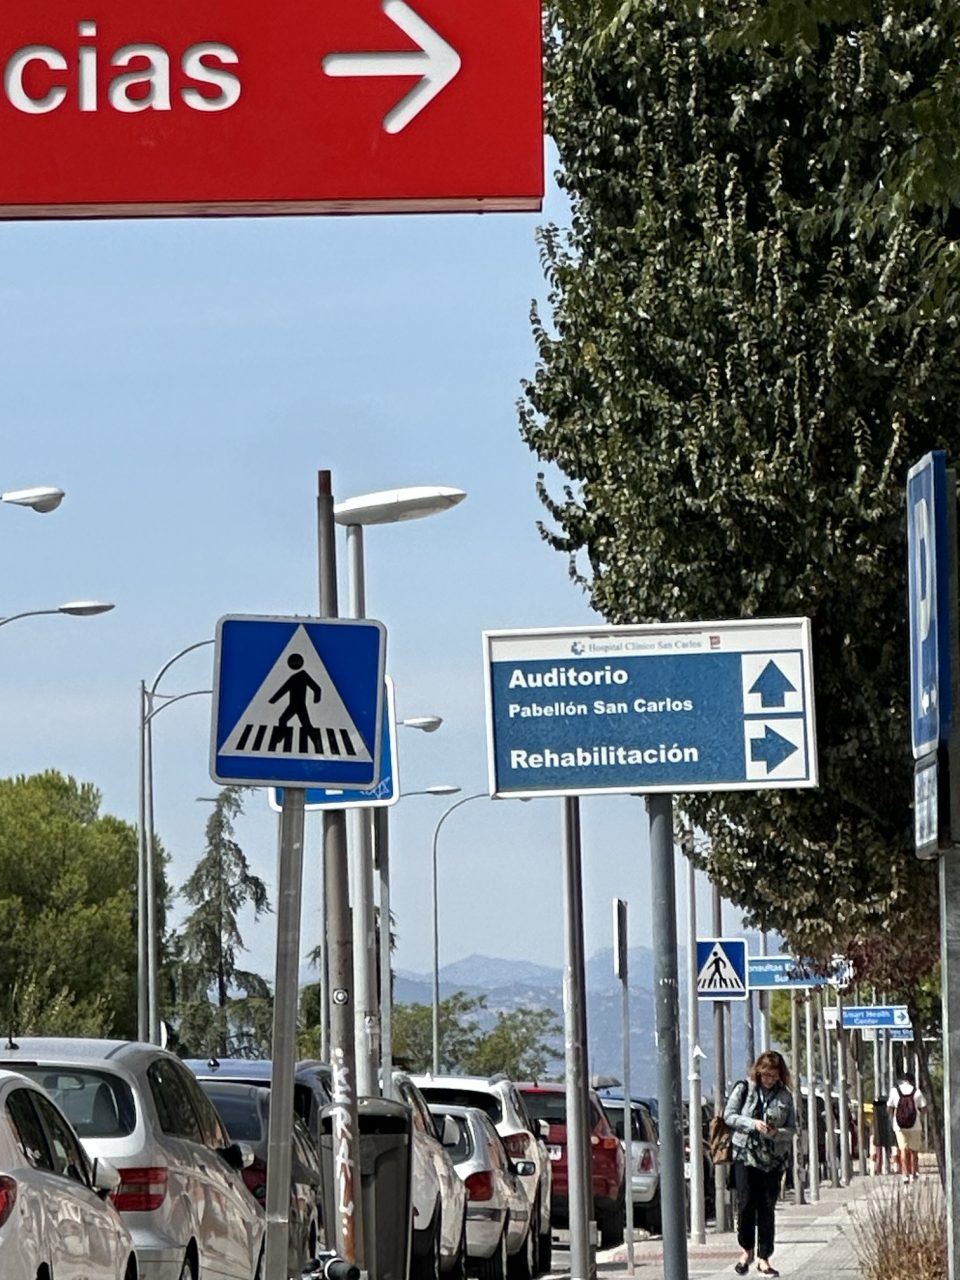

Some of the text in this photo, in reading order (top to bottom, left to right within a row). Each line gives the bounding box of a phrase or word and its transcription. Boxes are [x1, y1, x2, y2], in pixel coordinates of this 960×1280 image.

[657, 640, 673, 649] San
[674, 639, 702, 649] Carlos
[508, 665, 628, 689] Auditorio
[508, 697, 693, 718] Pabellón San Carlos
[510, 743, 699, 769] Rehabilitación
